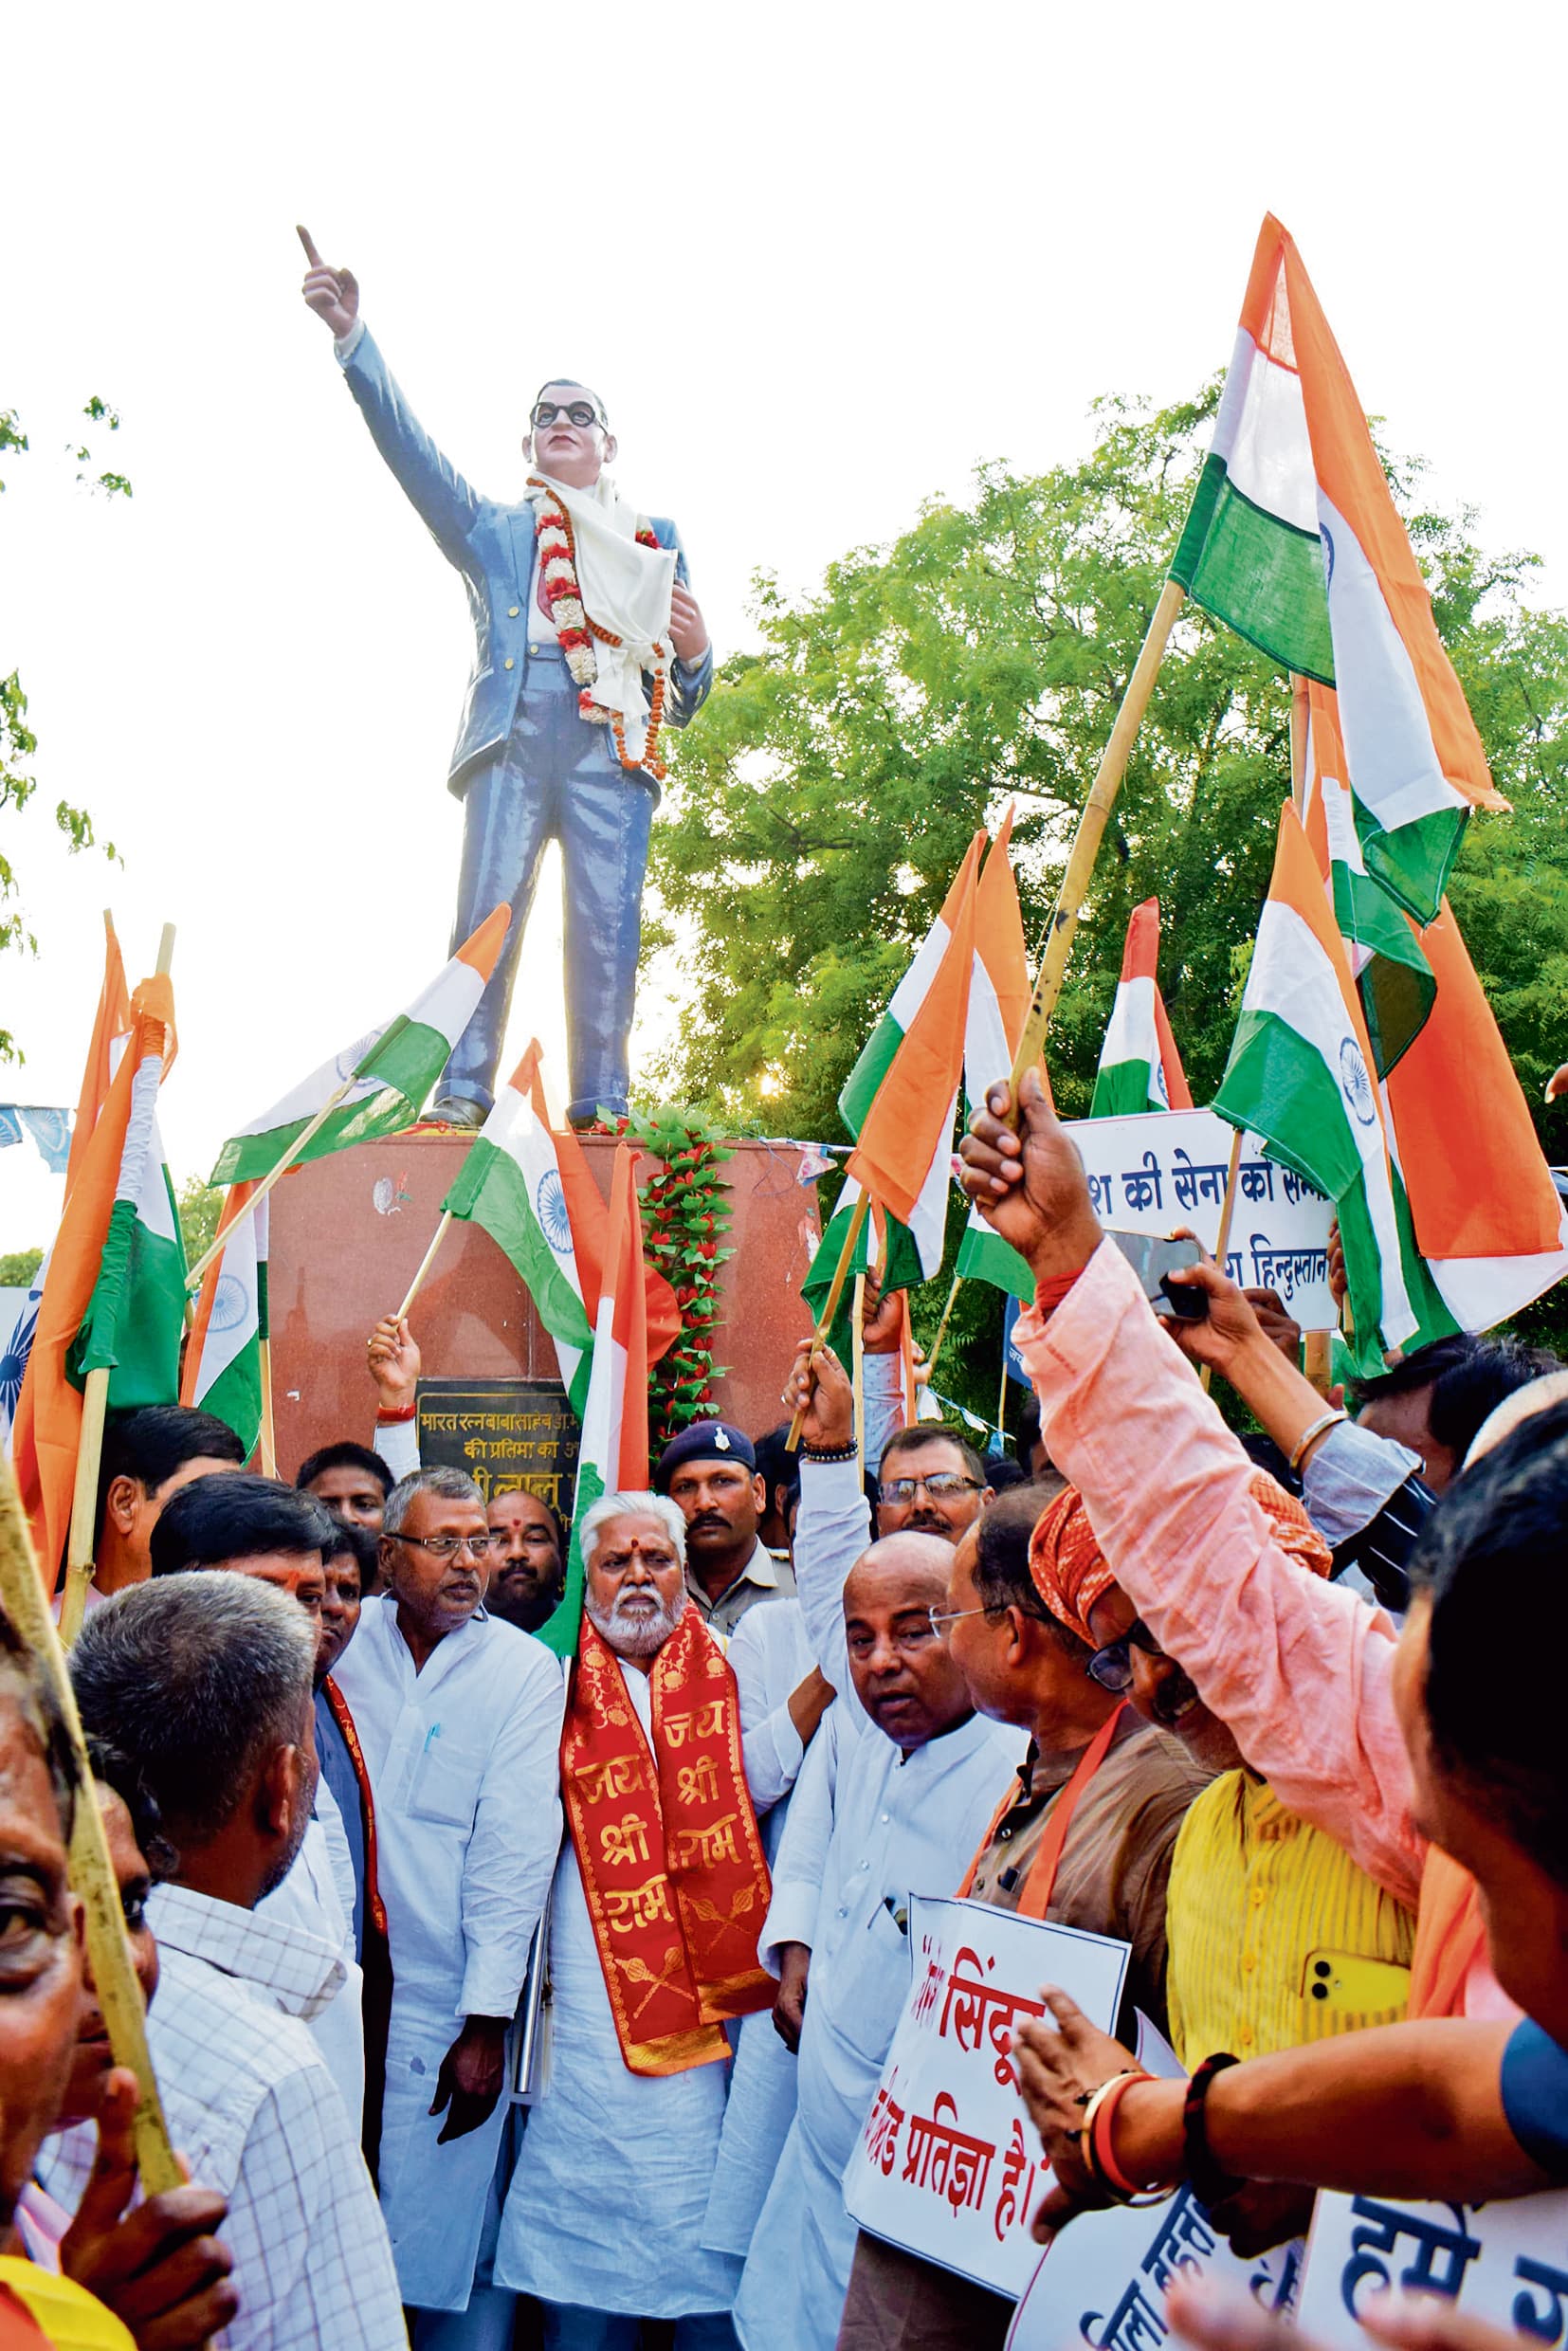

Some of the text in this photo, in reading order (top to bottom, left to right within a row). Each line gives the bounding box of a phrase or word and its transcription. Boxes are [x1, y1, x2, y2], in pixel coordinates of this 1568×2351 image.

[1121, 1151, 1162, 1212] की
[1172, 1148, 1229, 1212] सेना
[420, 1412, 458, 1431] भारत
[464, 1437, 487, 1459] की
[489, 1437, 535, 1459] प्रतिमा
[537, 1442, 559, 1459] का
[664, 1701, 726, 1748] जय
[575, 1755, 647, 1804] जय
[677, 1755, 720, 1806] श्री
[600, 1813, 651, 1866] श्री
[677, 1813, 742, 1869] राम
[604, 1873, 674, 1933] राम
[939, 1946, 1047, 2096] सिंदू
[903, 2091, 996, 2218] प्रतिज्ञा
